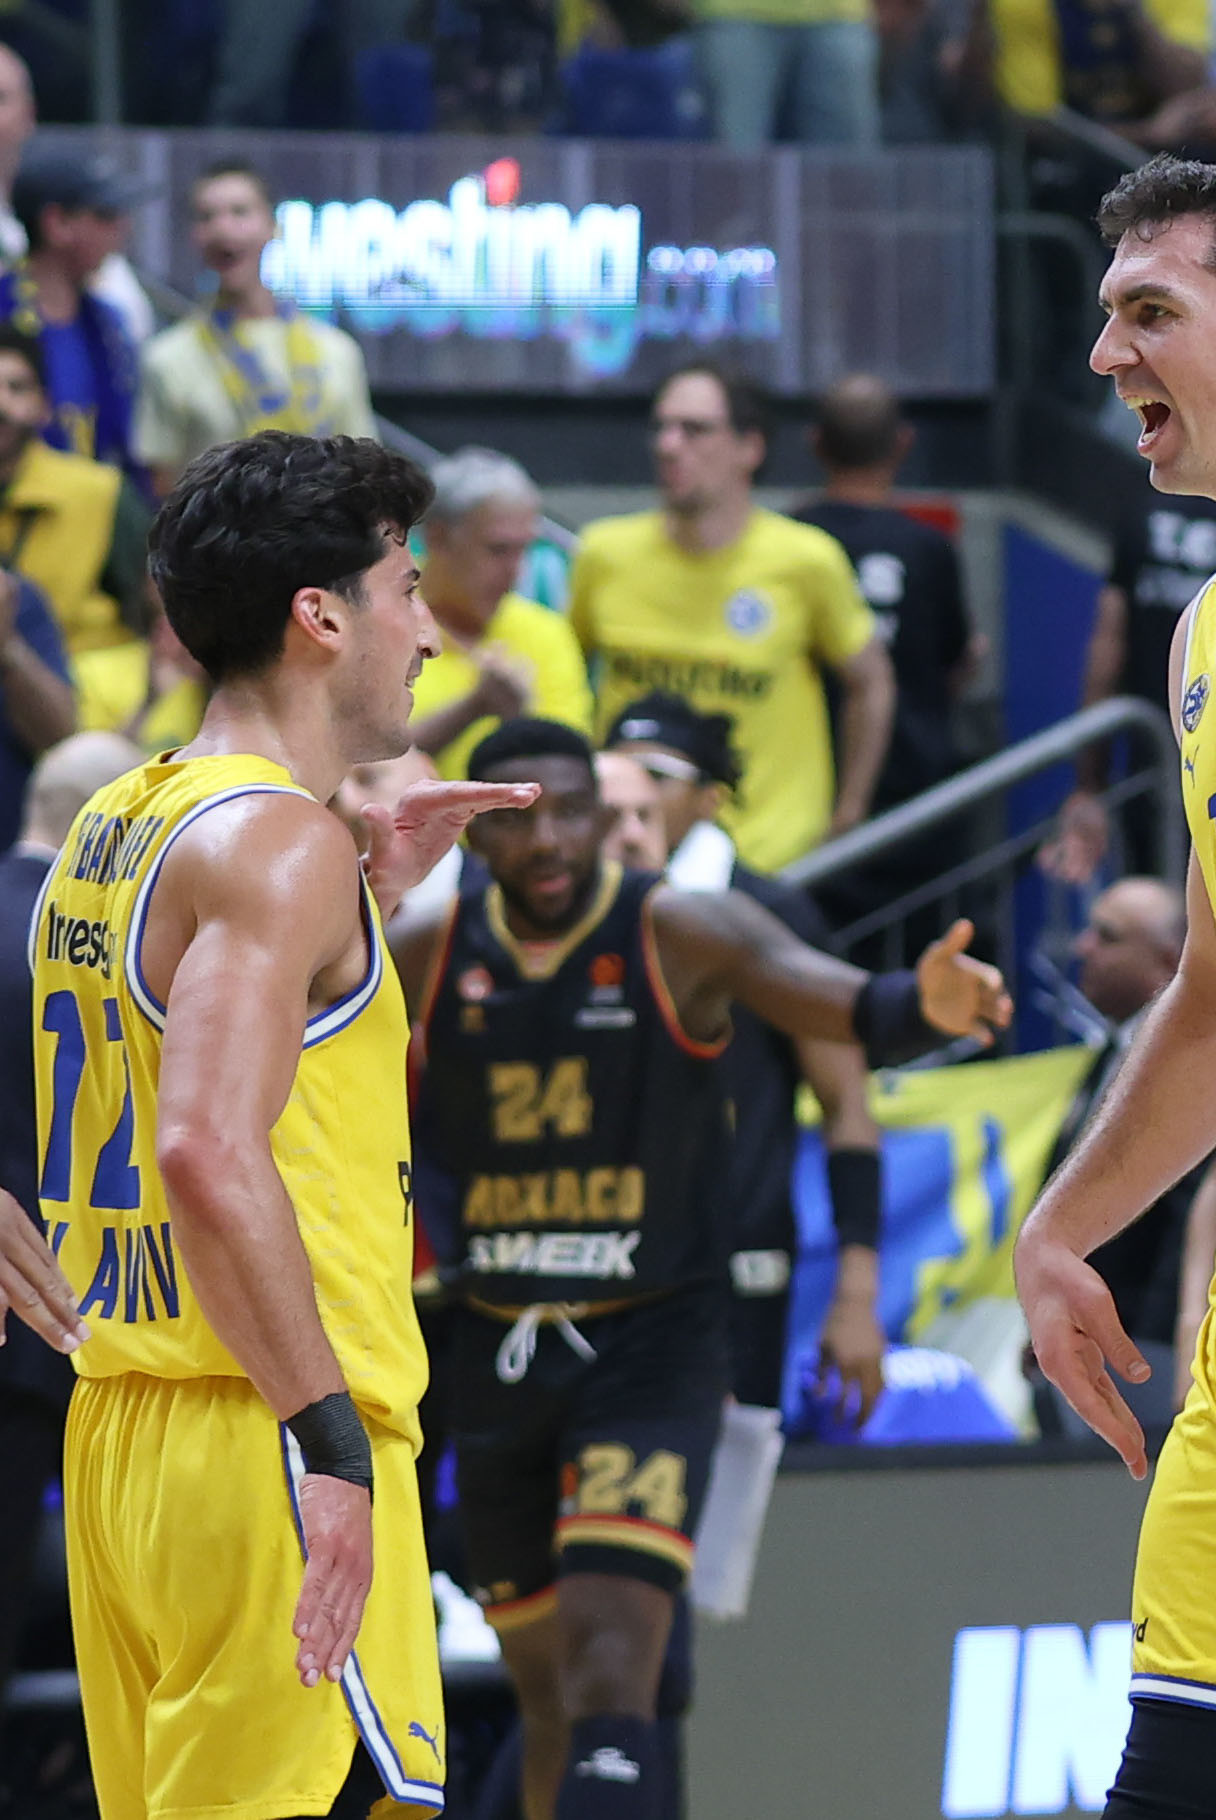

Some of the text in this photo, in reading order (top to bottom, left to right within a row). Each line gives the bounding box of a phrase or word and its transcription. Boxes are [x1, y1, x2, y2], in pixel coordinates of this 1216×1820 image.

[39, 990, 140, 1210] 12
[490, 1056, 593, 1144] 24
[578, 1440, 688, 1530] 24
